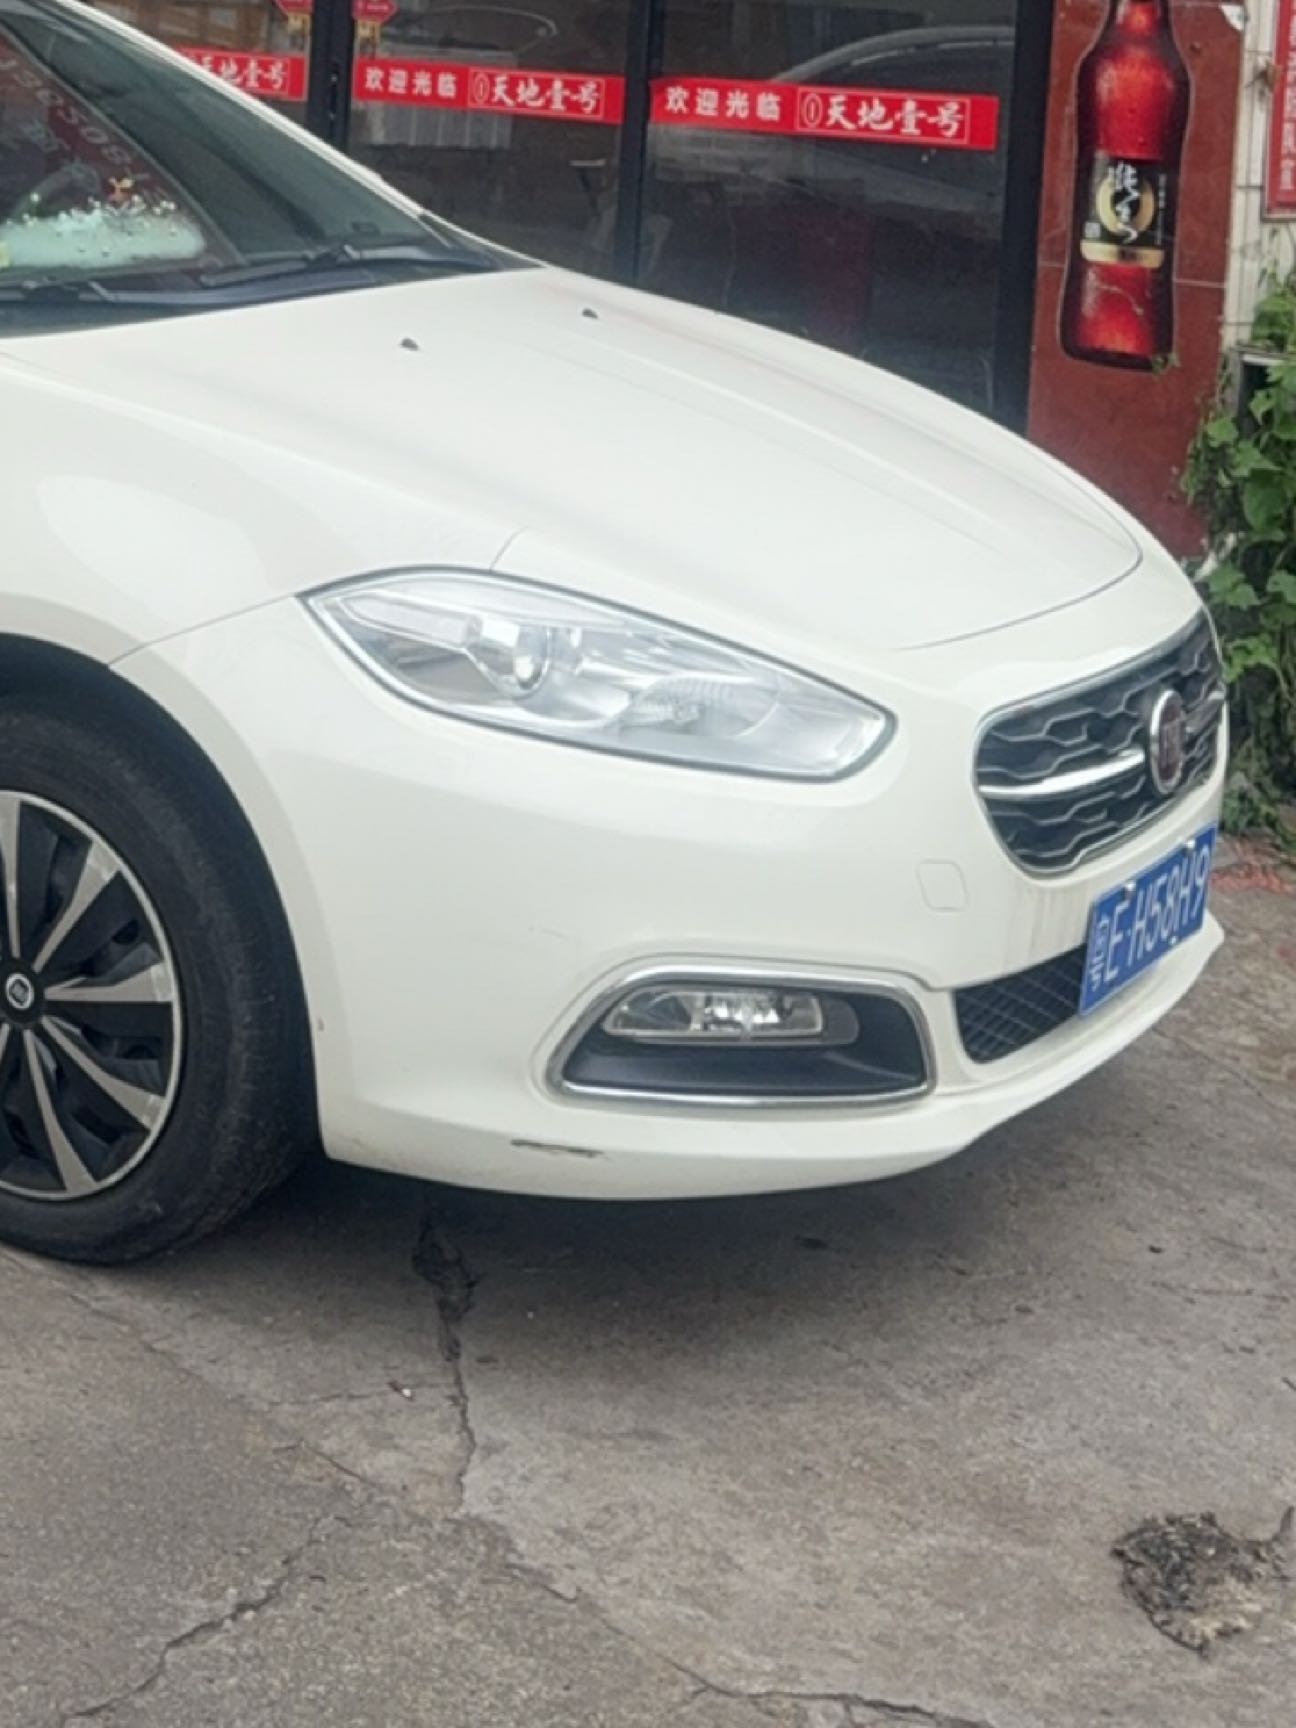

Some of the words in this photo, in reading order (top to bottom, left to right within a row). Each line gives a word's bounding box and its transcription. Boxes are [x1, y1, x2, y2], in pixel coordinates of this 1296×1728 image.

[364, 66, 457, 99] 欢迎光临
[491, 74, 600, 114] 天地壹号
[665, 85, 781, 121] 欢迎光临
[825, 93, 964, 138] 天地壹号
